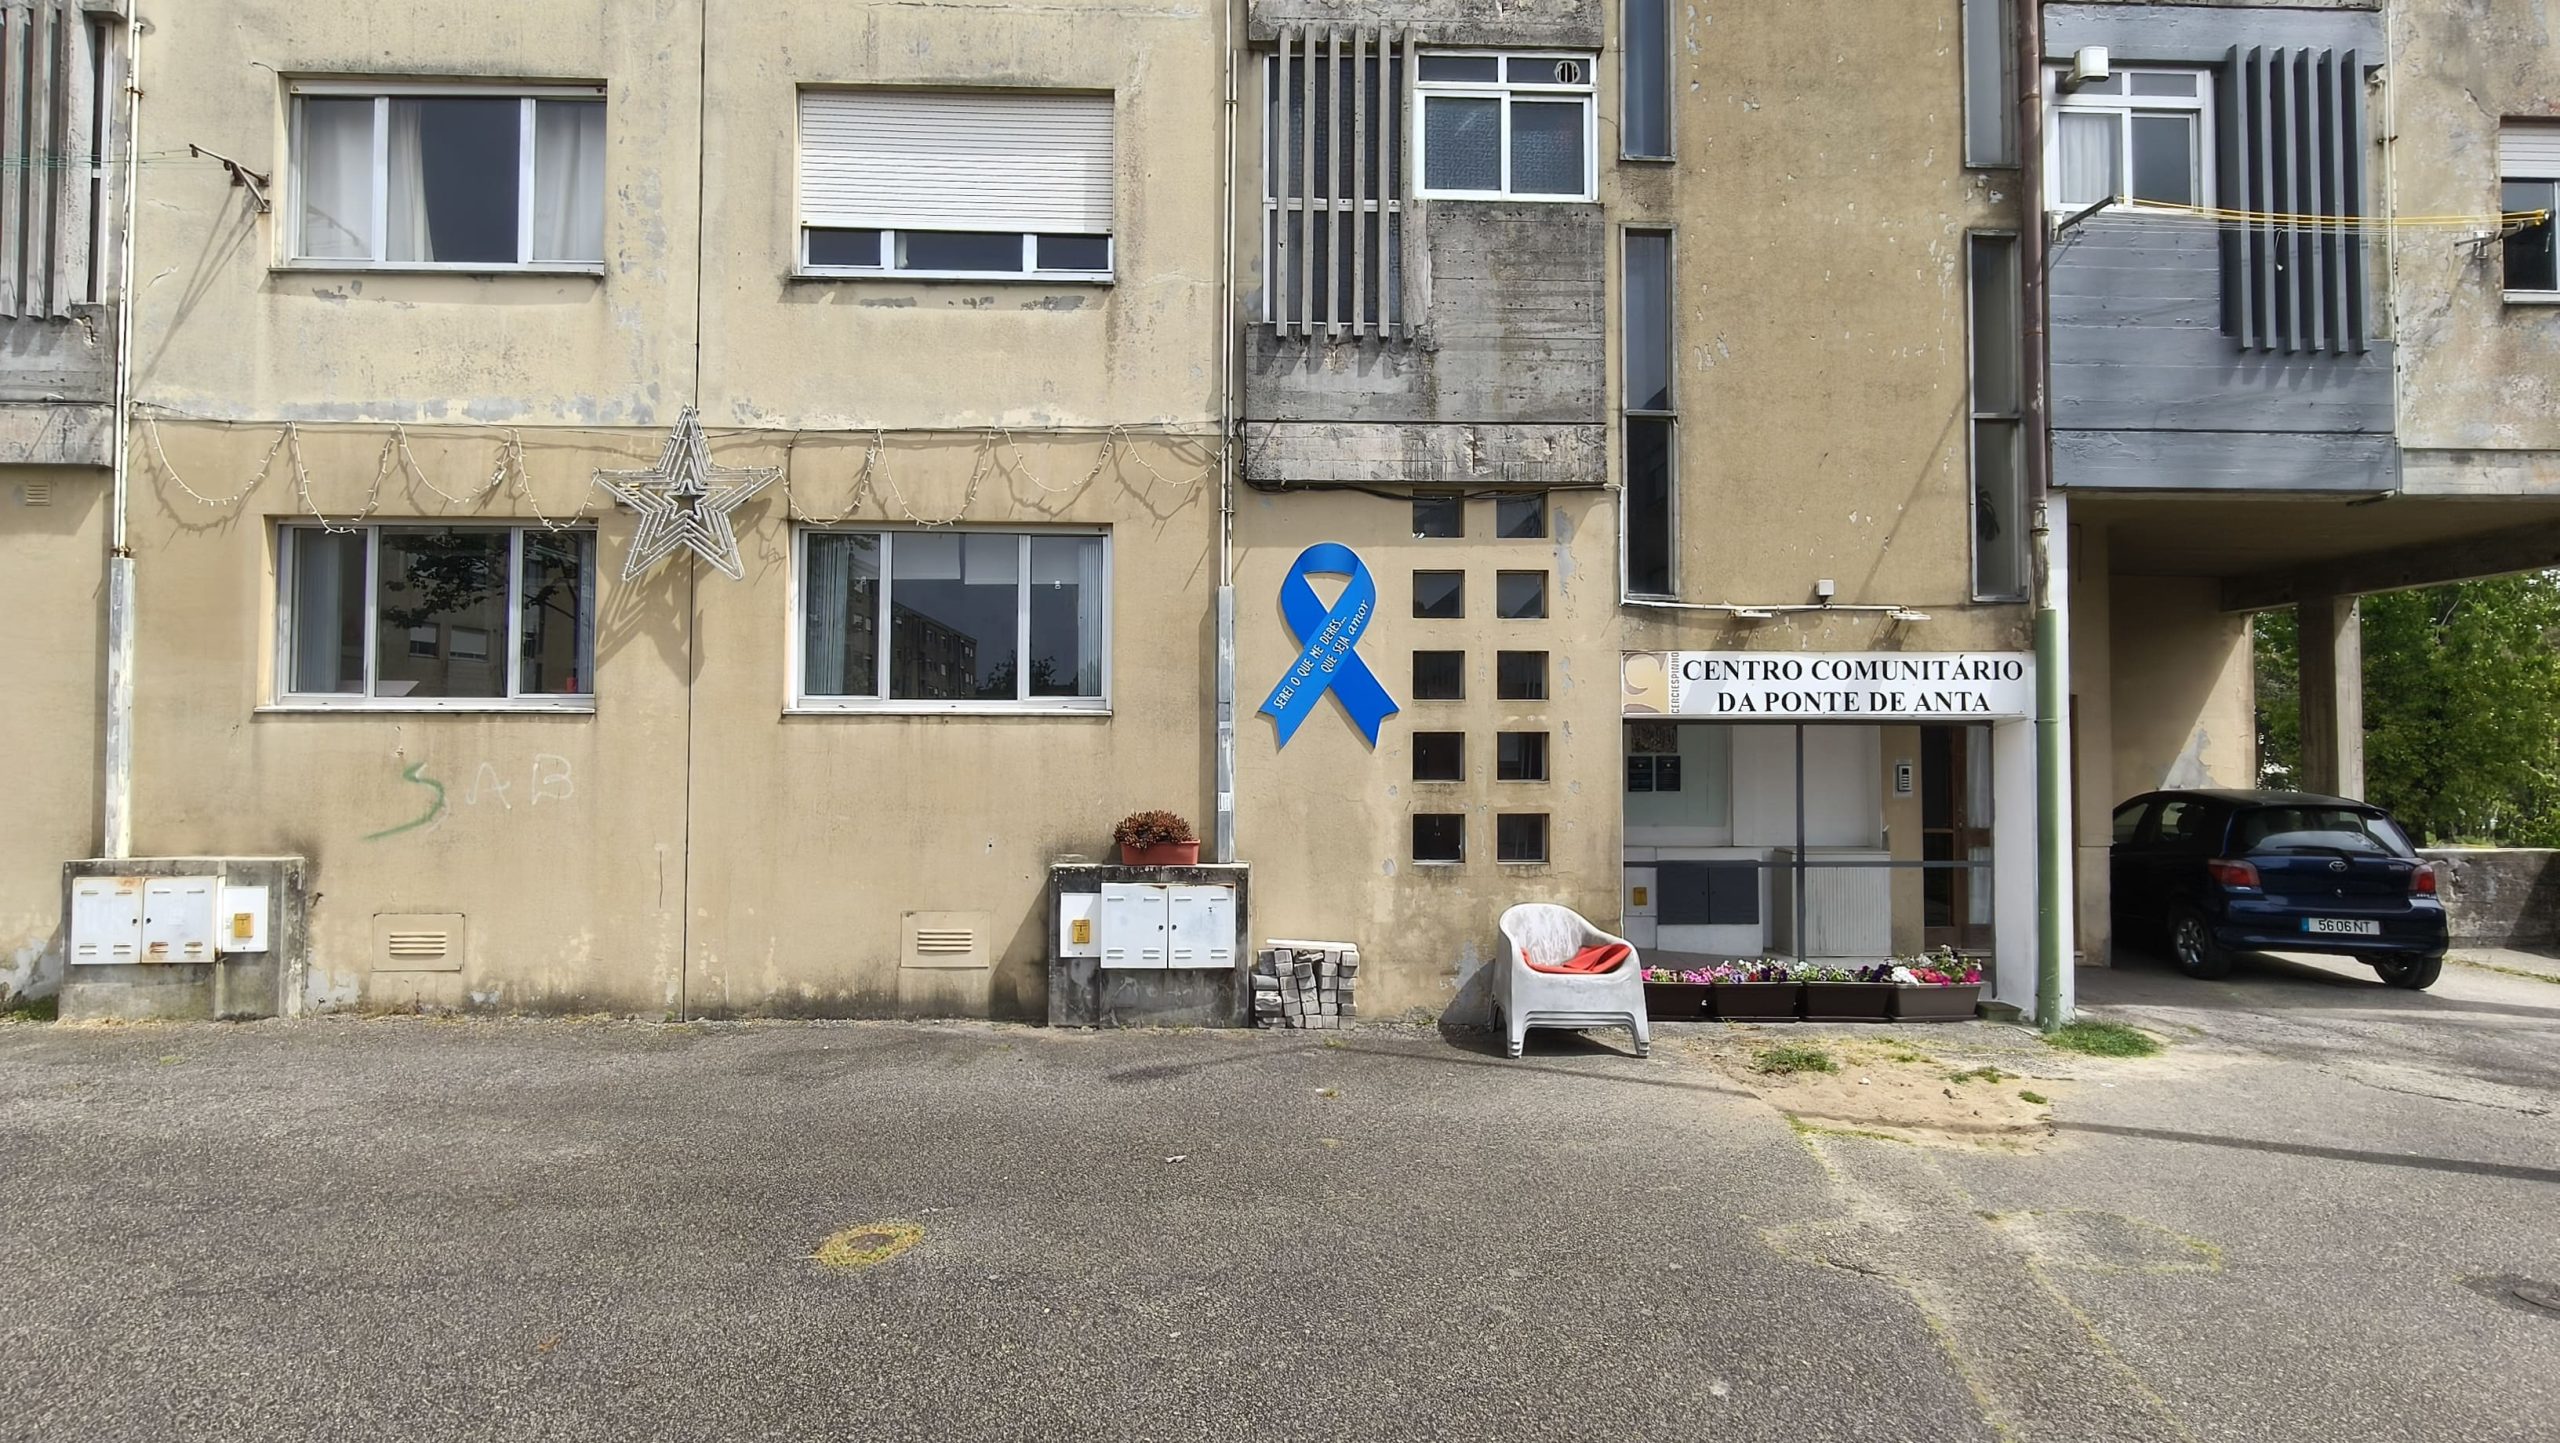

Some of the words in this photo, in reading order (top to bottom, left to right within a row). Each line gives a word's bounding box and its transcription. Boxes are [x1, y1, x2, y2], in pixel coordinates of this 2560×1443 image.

[1320, 654, 1338, 673] QUE
[1332, 636, 1350, 655] SEJA
[1348, 599, 1369, 635] amor
[1274, 685, 1295, 709] SEREI
[1291, 677, 1301, 686] O
[1297, 658, 1315, 676] QUE
[1309, 644, 1324, 660] ME
[1682, 660, 1801, 681] CENTRO
[1810, 655, 2024, 681] COMUNITÁRIO
[1717, 691, 1756, 712] DA
[1765, 691, 1860, 712] PONTE
[1869, 691, 1907, 712] DE
[1915, 691, 1991, 712] ANTA
